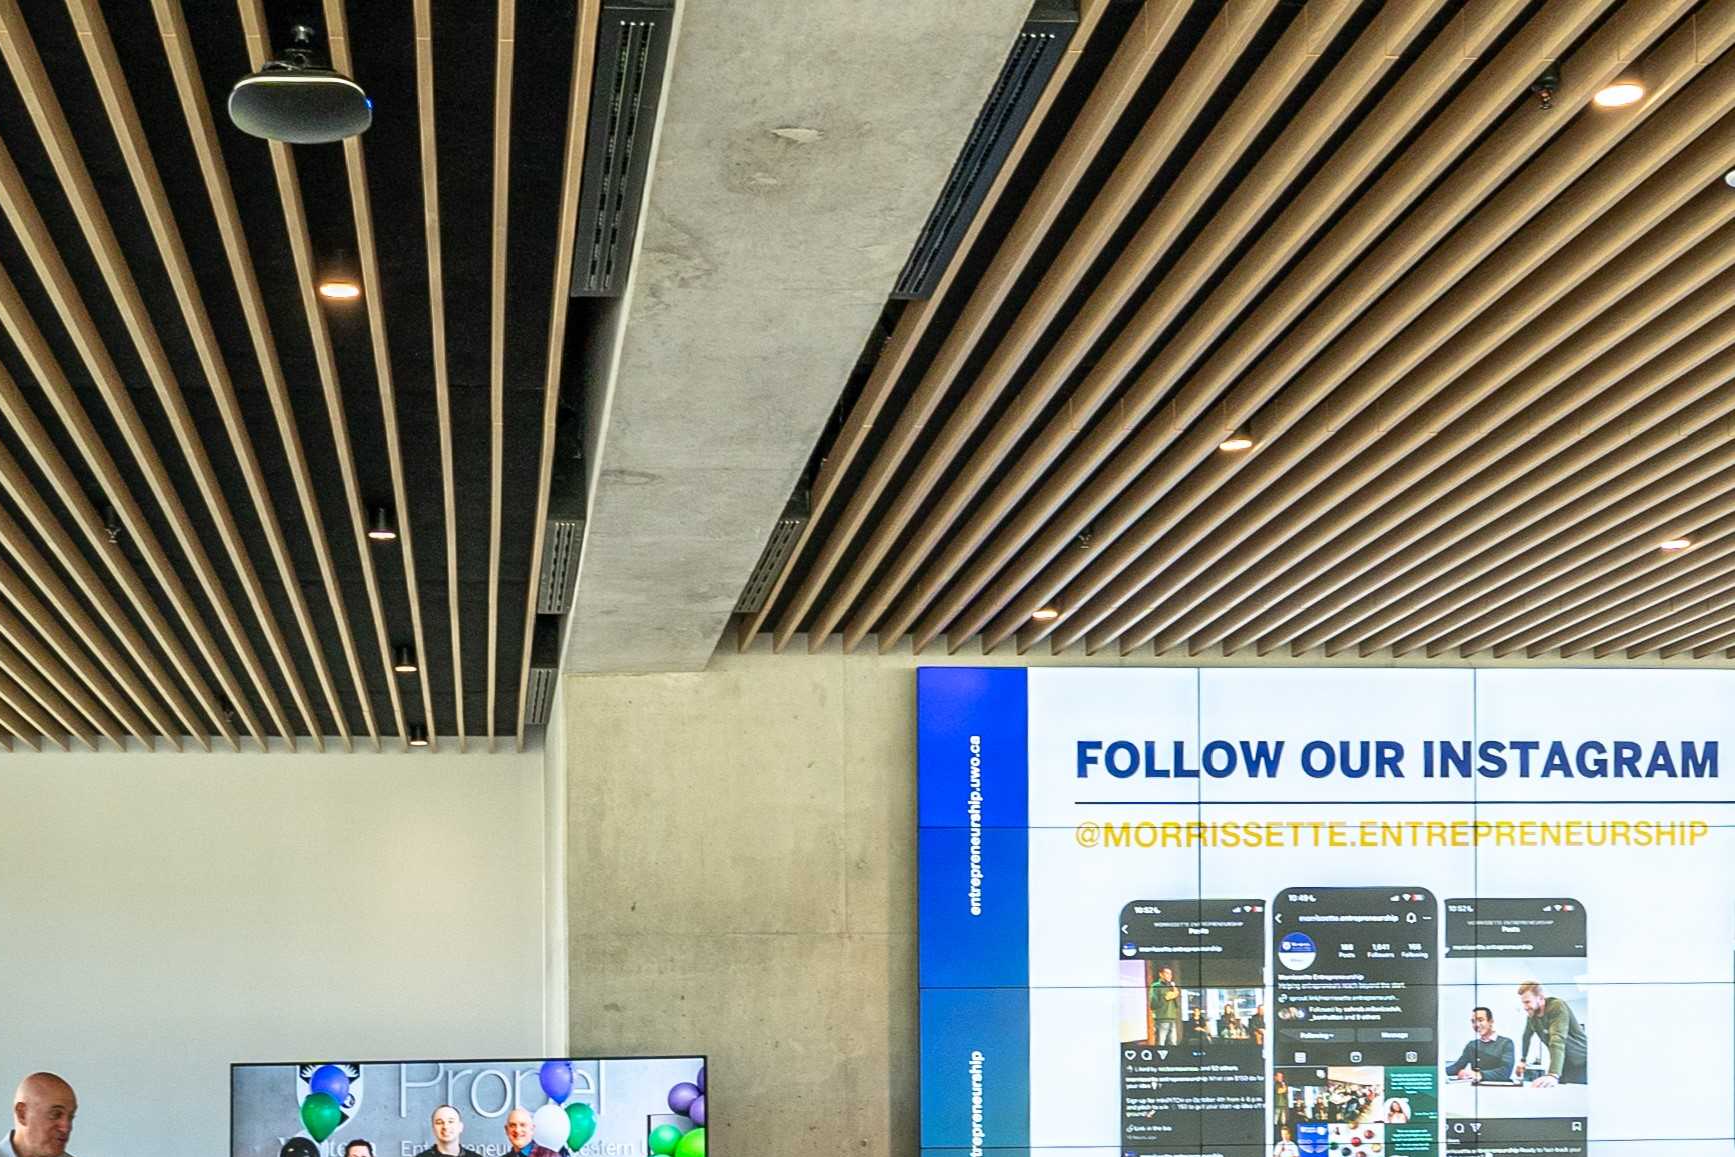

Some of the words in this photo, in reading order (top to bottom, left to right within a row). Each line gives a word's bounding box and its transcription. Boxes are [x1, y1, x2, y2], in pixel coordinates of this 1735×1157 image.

[1076, 740, 1285, 778] FOLLOW
[1301, 740, 1405, 778] OUR
[1423, 740, 1719, 778] INSTAGRAM
[968, 735, 983, 917] entrepreneurship.uwo.ca
[1074, 820, 1709, 849] @MORRISSETTE.ENTREPRENEURSHIP
